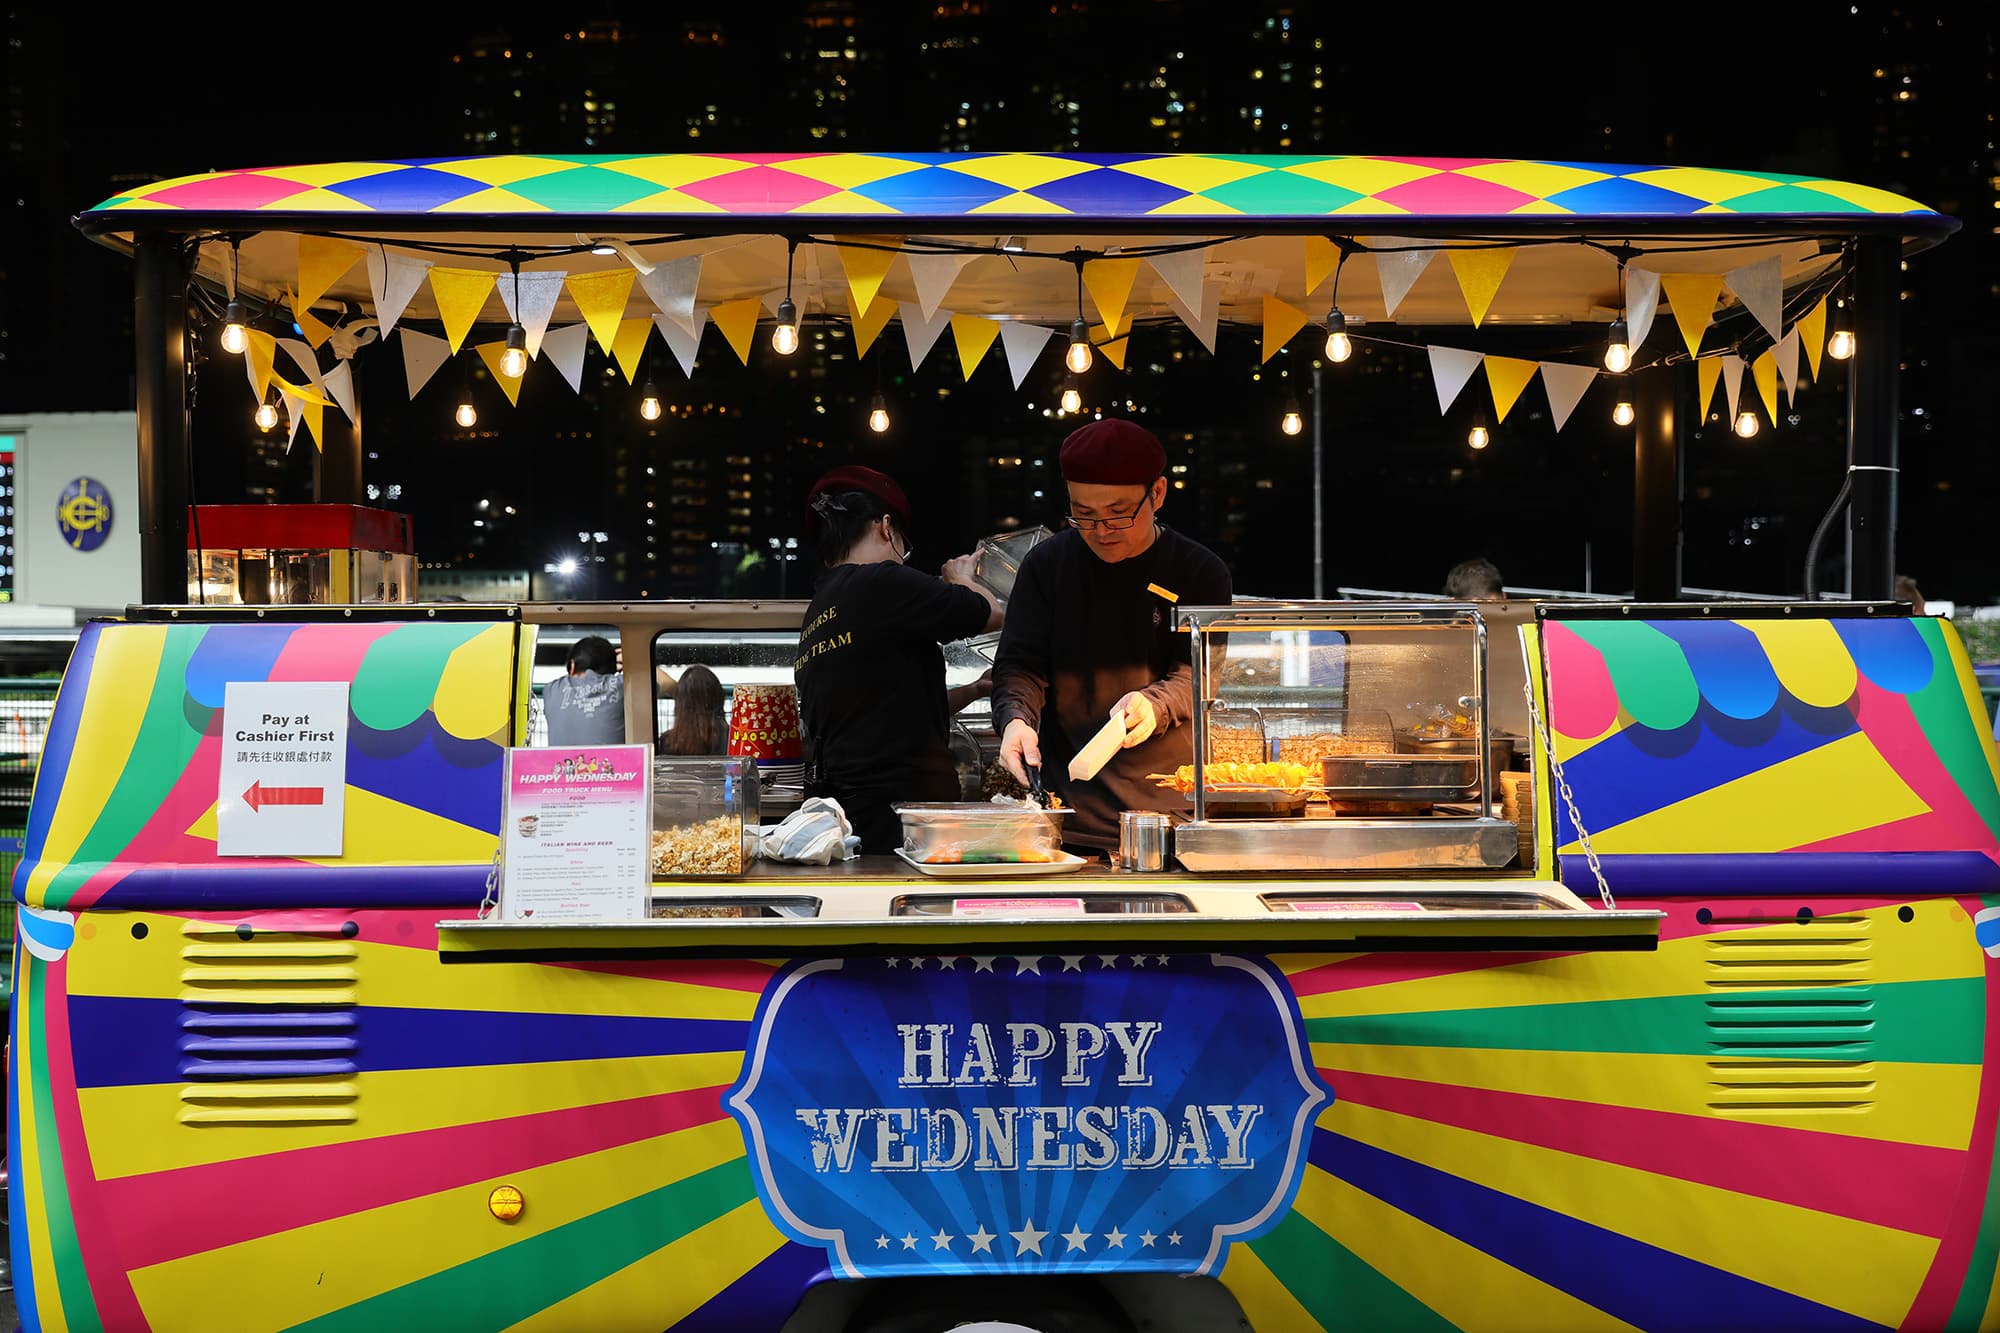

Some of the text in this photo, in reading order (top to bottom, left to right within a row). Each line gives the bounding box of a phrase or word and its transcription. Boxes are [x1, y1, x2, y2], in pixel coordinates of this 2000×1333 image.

[811, 631, 853, 657] TEAM
[262, 714, 310, 727] Pay at
[235, 730, 335, 742] Cashier First
[733, 726, 797, 742] popcorn
[237, 751, 333, 763] 請先往收銀處付款
[519, 772, 637, 784] HAPPY WEDNESDAY
[897, 1021, 1162, 1087] HAPPY
[795, 1103, 1264, 1173] WEDNESDAY
